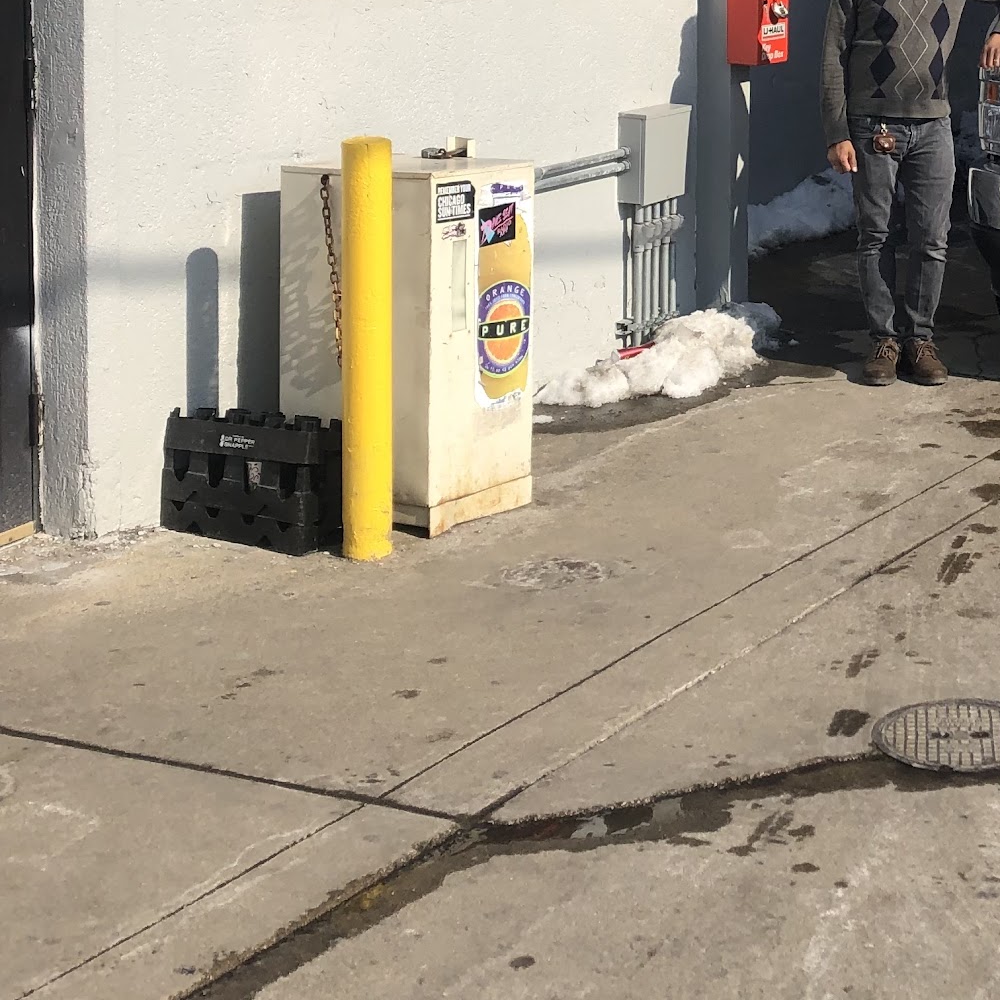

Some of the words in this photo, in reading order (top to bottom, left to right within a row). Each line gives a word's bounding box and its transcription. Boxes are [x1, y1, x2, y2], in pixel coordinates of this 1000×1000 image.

[763, 25, 784, 35] U-HAUL
[437, 194, 466, 207] CHICAGO
[485, 284, 526, 302] ORANGE
[481, 319, 527, 337] PURE
